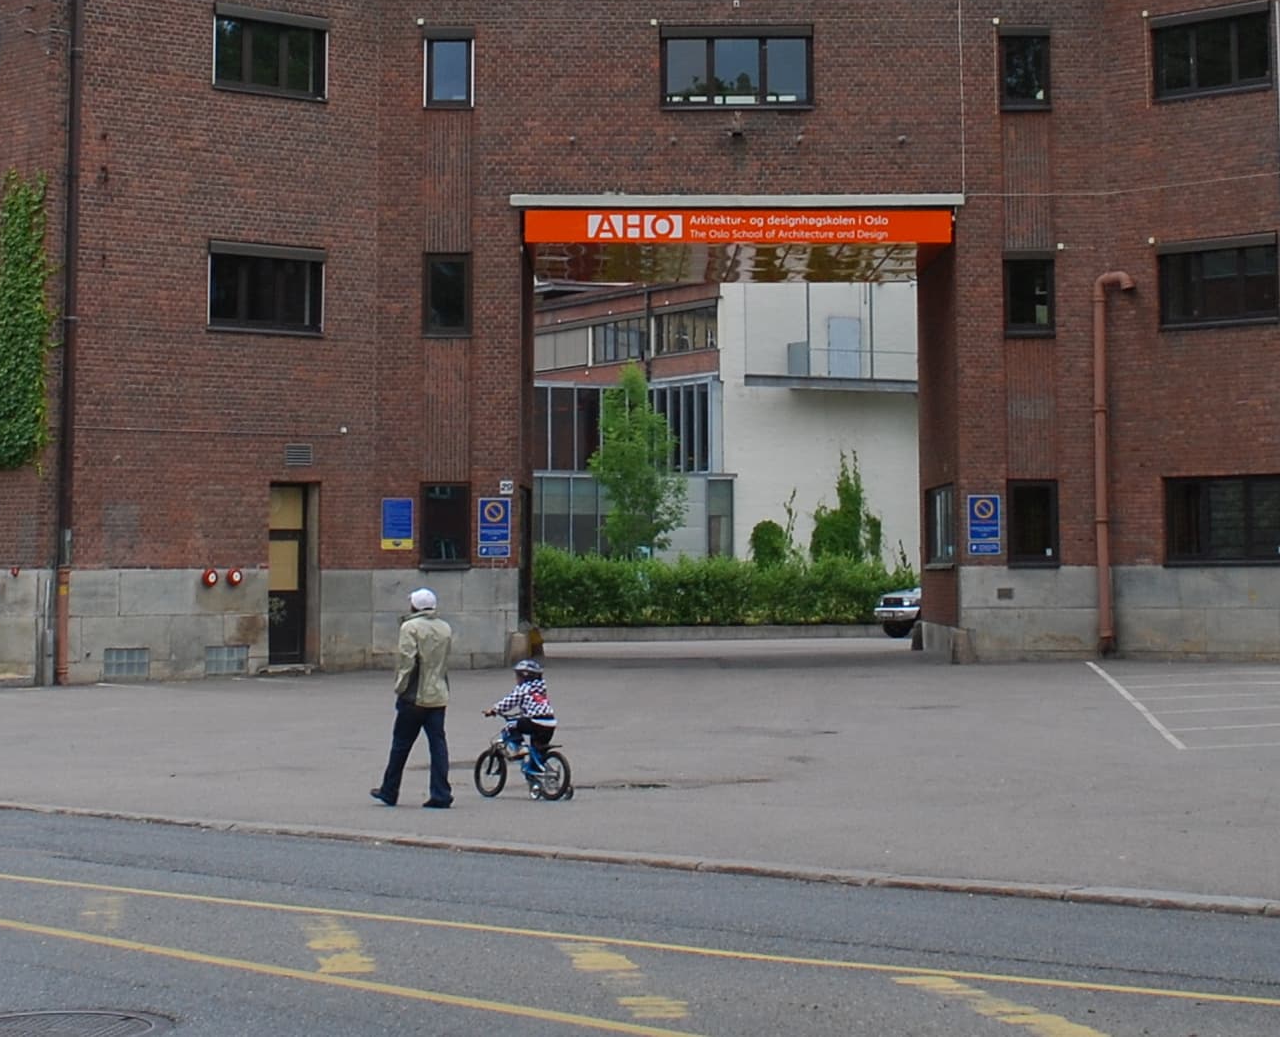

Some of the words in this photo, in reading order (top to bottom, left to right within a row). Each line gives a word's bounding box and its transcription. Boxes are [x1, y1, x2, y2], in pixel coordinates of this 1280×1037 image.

[587, 214, 683, 238] AHO
[690, 215, 746, 225] Arkitektur-
[749, 217, 764, 227] og
[767, 215, 856, 227] designhøgskolen
[864, 215, 889, 225] Oslo
[690, 229, 707, 238] The
[708, 229, 730, 238] Oslo
[732, 229, 763, 239] School
[765, 229, 776, 239] of
[777, 229, 835, 239] Architecture
[836, 230, 855, 239] and
[857, 230, 889, 241] Design
[501, 483, 513, 491] 29
